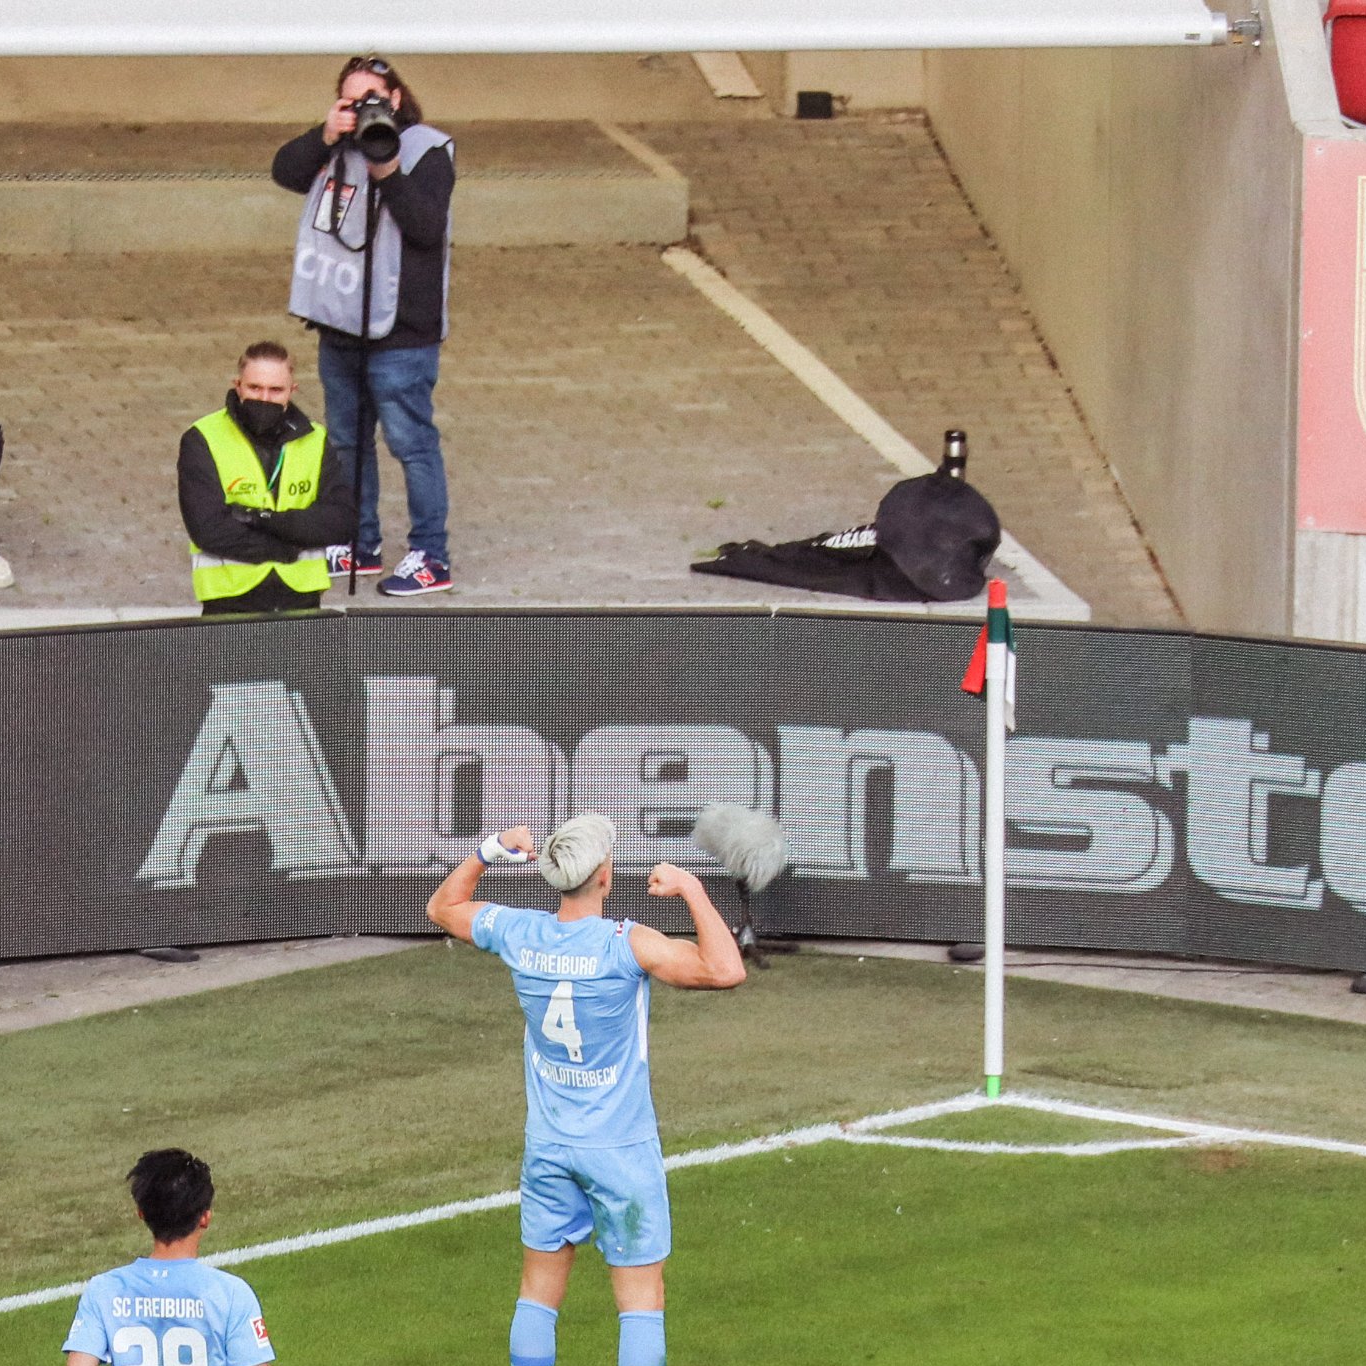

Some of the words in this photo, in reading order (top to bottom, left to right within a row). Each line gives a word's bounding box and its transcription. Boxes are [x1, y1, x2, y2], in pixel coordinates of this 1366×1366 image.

[519, 947, 534, 969] SC
[534, 951, 597, 976] FREIBURG
[541, 980, 583, 1063] 4
[112, 1297, 131, 1317] SC
[135, 1297, 204, 1319] FREIBURG
